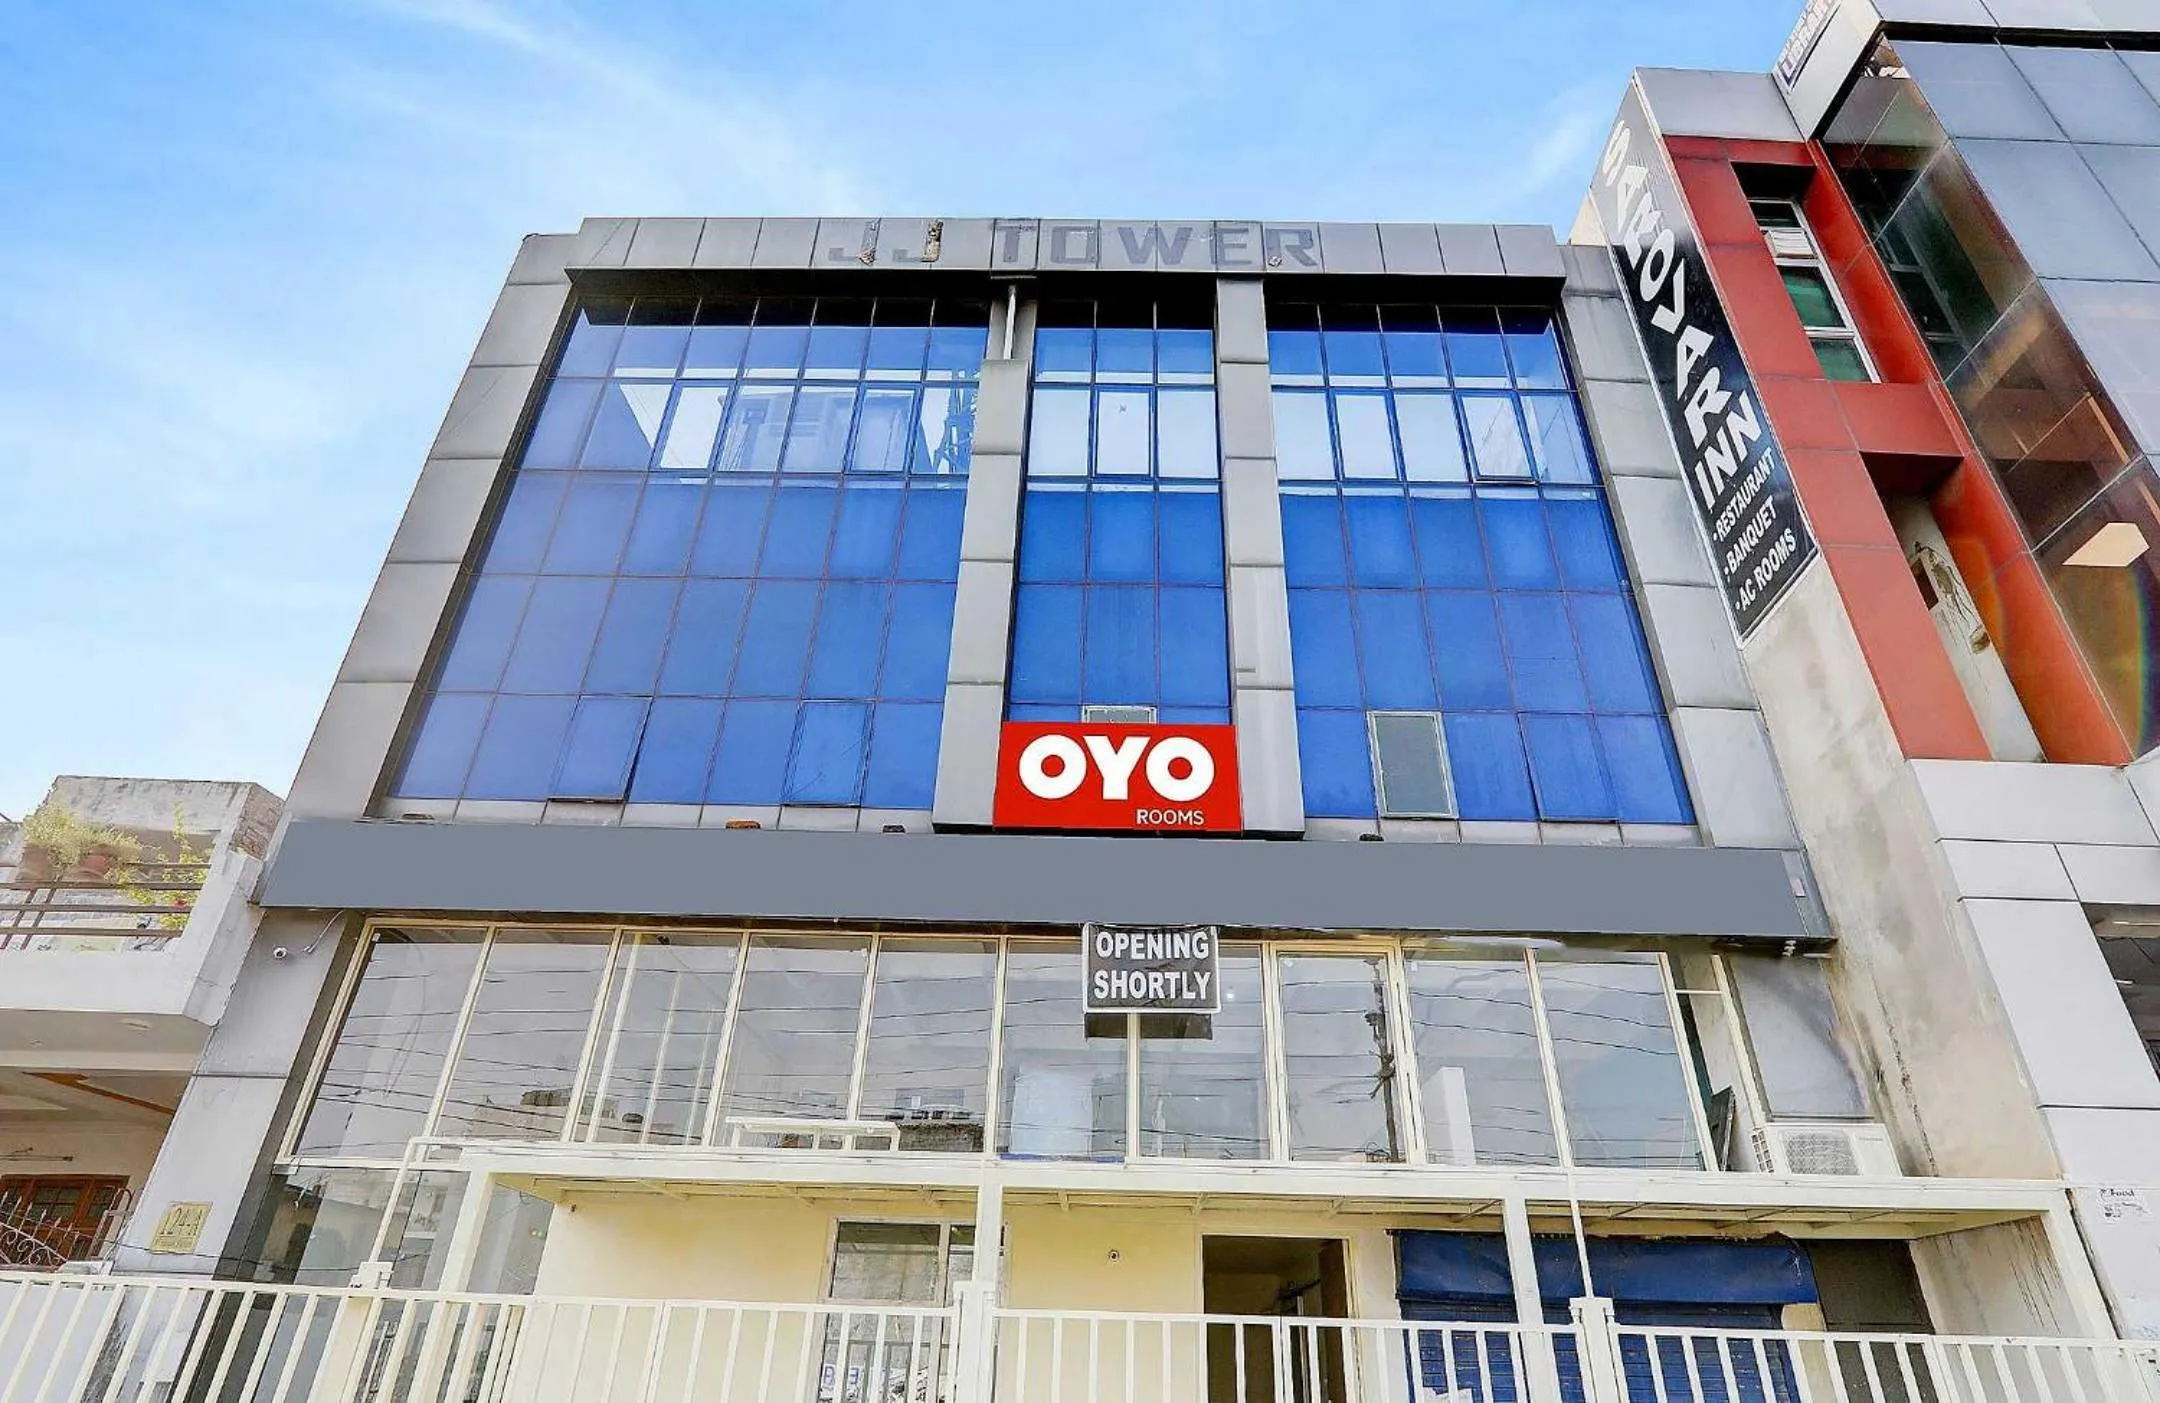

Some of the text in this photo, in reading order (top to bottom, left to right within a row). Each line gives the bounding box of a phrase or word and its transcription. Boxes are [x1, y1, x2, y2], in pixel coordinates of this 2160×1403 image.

[829, 219, 1318, 266] JJ TOWER
[1602, 120, 1733, 450] SAROVAR
[1693, 390, 1762, 510] INN
[1715, 446, 1775, 542] RESTAURANT
[1726, 495, 1777, 575] BANQUET
[1739, 528, 1797, 612] AC ROOMS
[1019, 734, 1215, 801] OYO
[1136, 808, 1204, 825] ROOMS
[1096, 931, 1209, 960] OPENING
[1094, 970, 1211, 1000] SHORTLY
